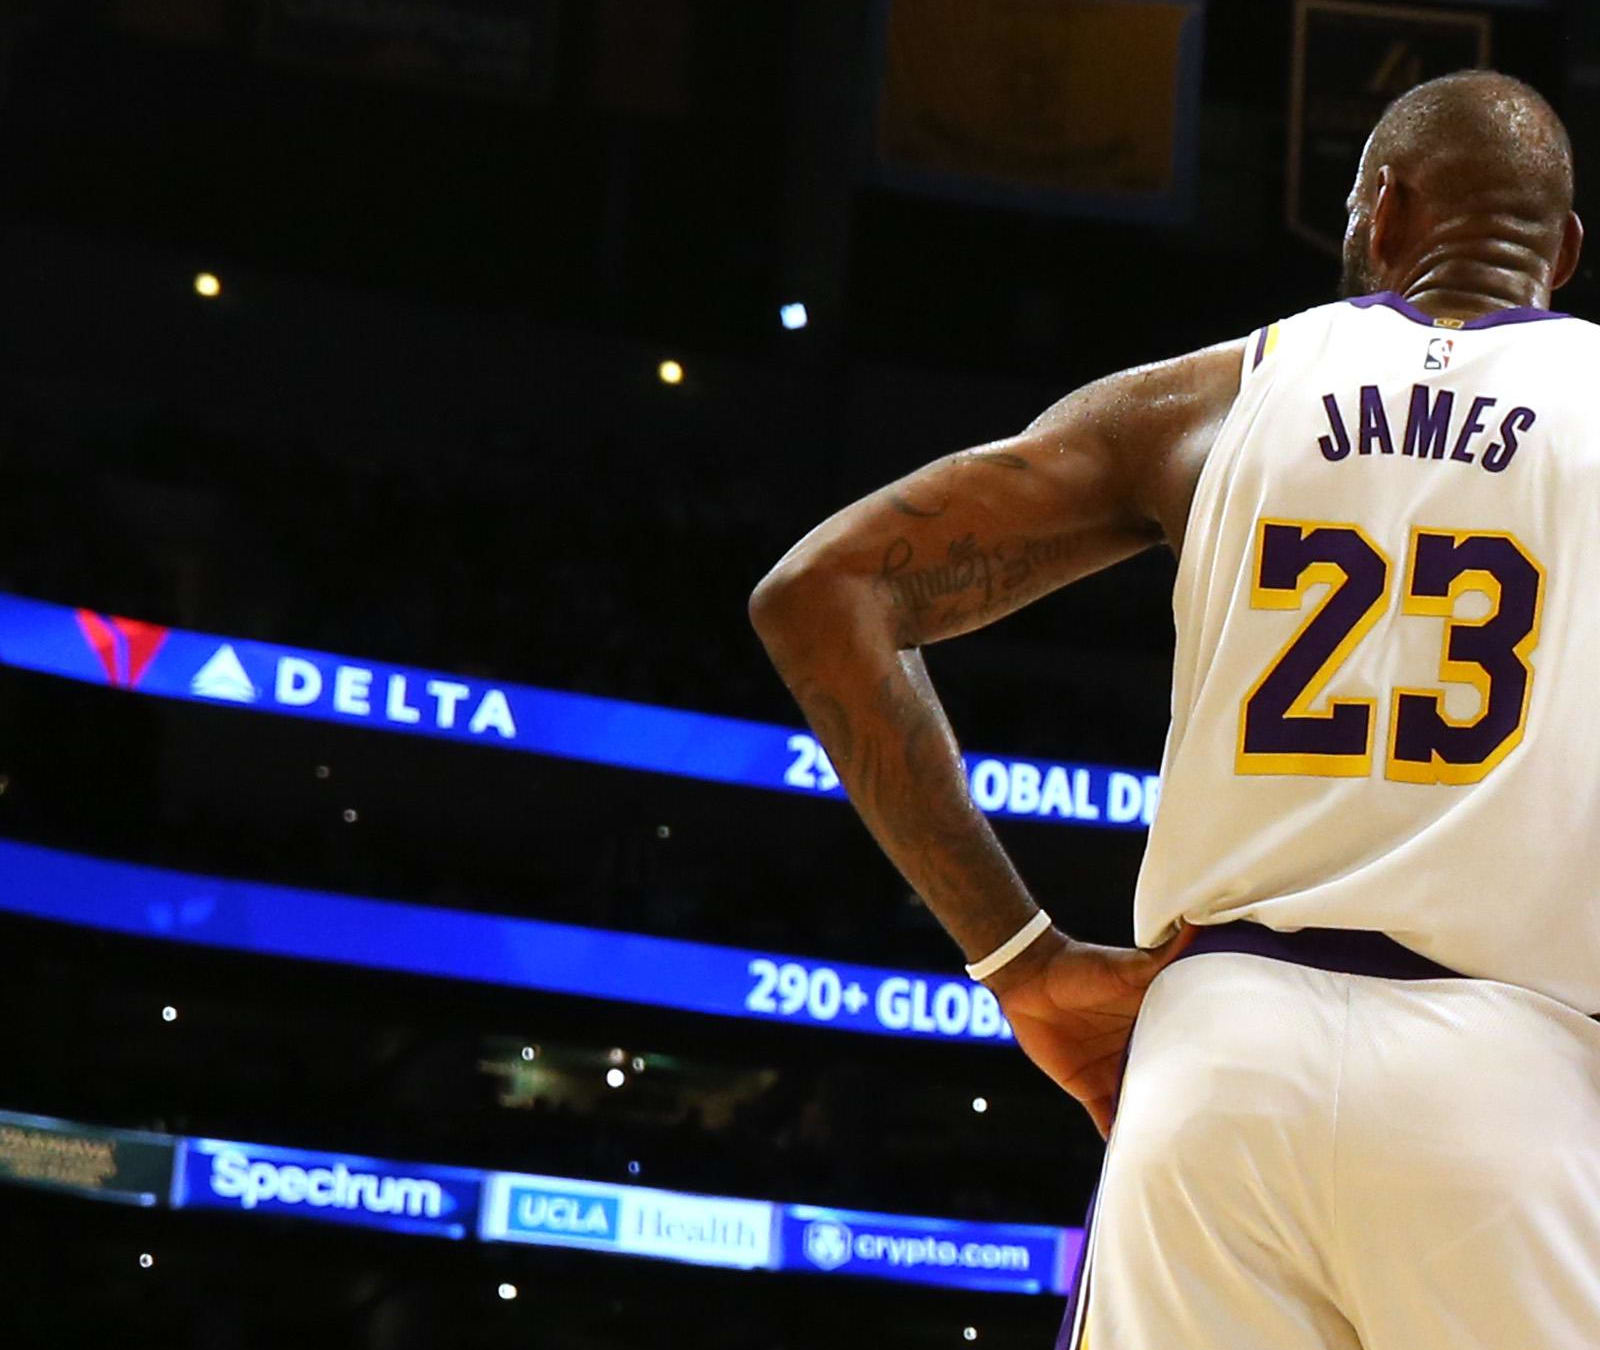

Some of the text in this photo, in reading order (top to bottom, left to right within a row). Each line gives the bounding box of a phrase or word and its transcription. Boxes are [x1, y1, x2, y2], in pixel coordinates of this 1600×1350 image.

[1318, 384, 1536, 473] JAMES
[1234, 518, 1547, 786] 23
[274, 655, 516, 739] DELTA
[971, 760, 1098, 820] OBAL
[746, 957, 1015, 1040] 290+ GLOB
[209, 1149, 444, 1218] Spectrum
[516, 1190, 758, 1251] UCLA Health
[854, 1227, 1031, 1273] crypto.com
